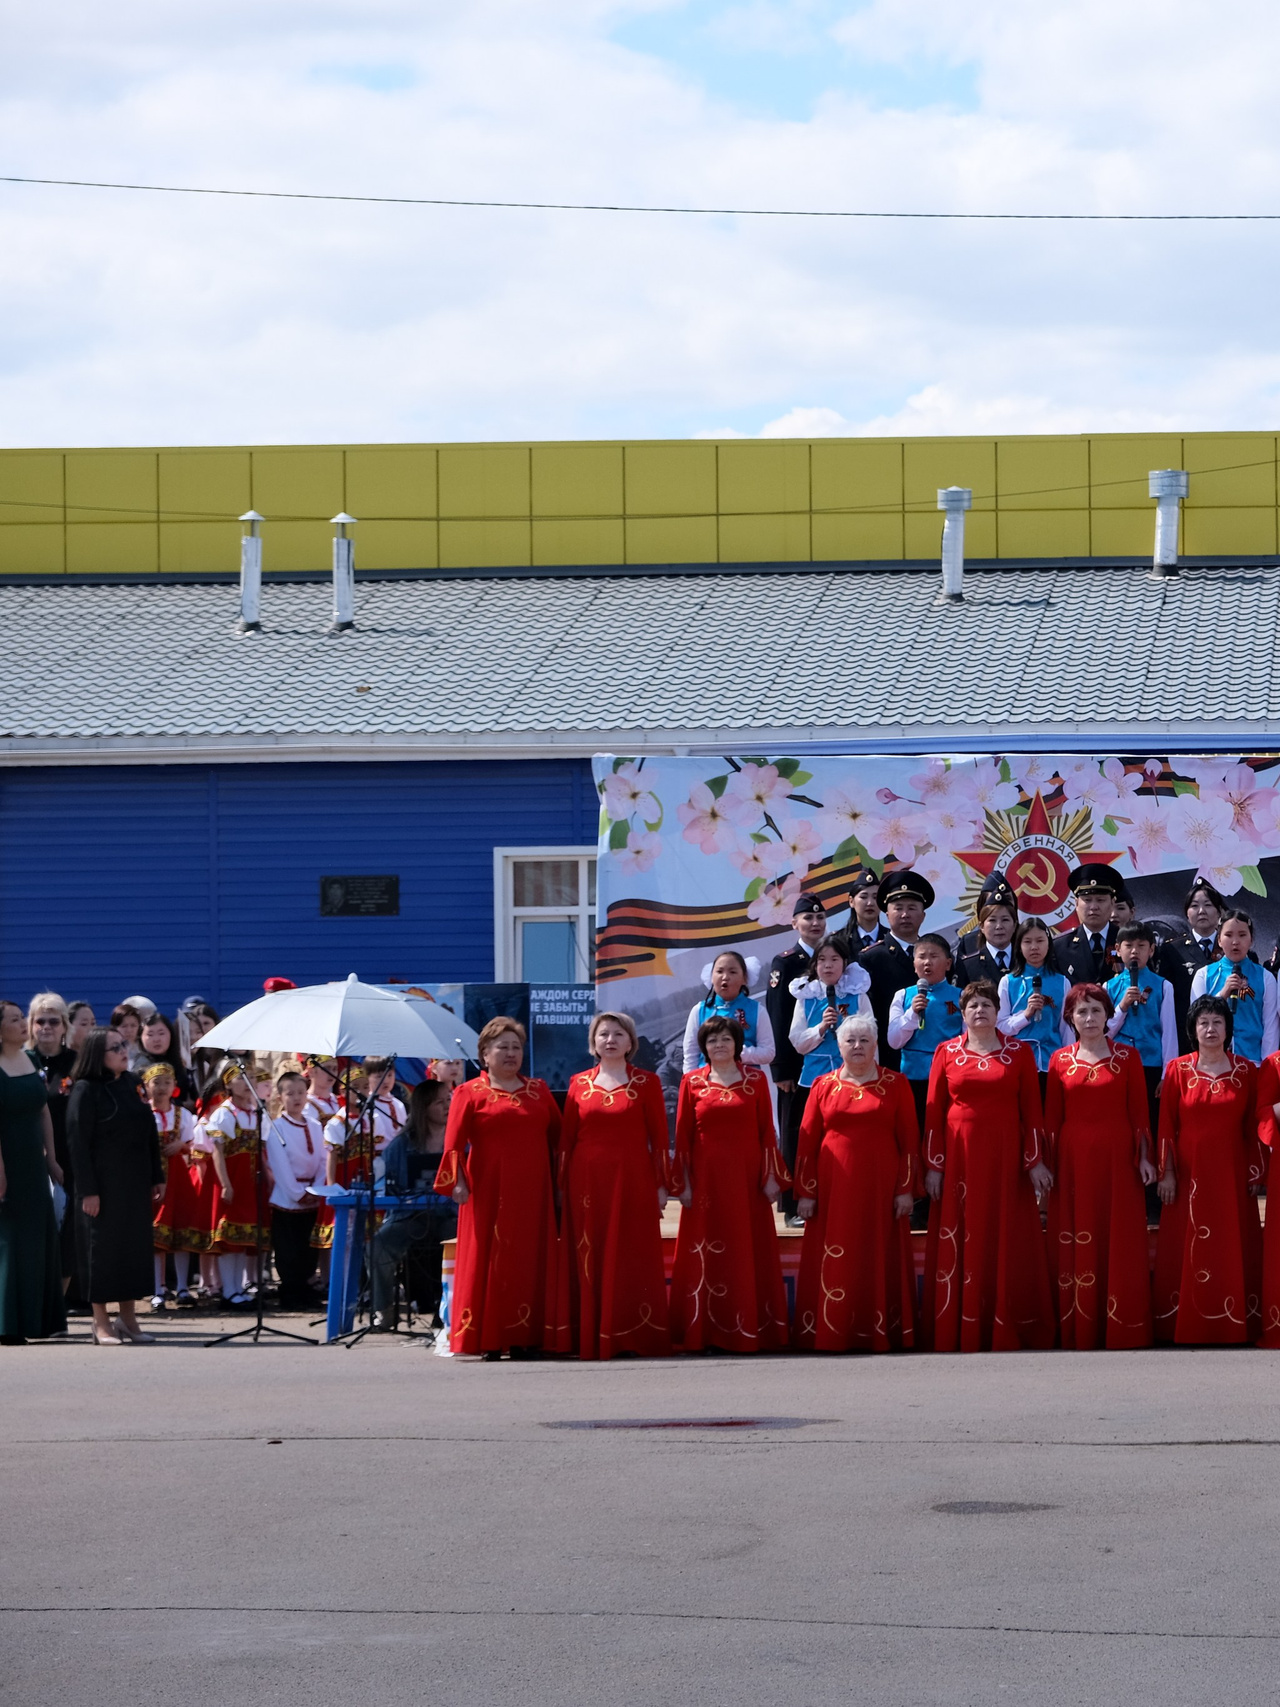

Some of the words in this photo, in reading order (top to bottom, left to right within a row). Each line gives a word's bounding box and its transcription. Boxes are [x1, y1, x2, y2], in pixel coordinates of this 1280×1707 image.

[997, 836, 1075, 870] СТВЕННАЯ
[542, 1002, 587, 1012] ЗАБЫТЫ
[536, 1014, 580, 1025] ПАВШИХ
